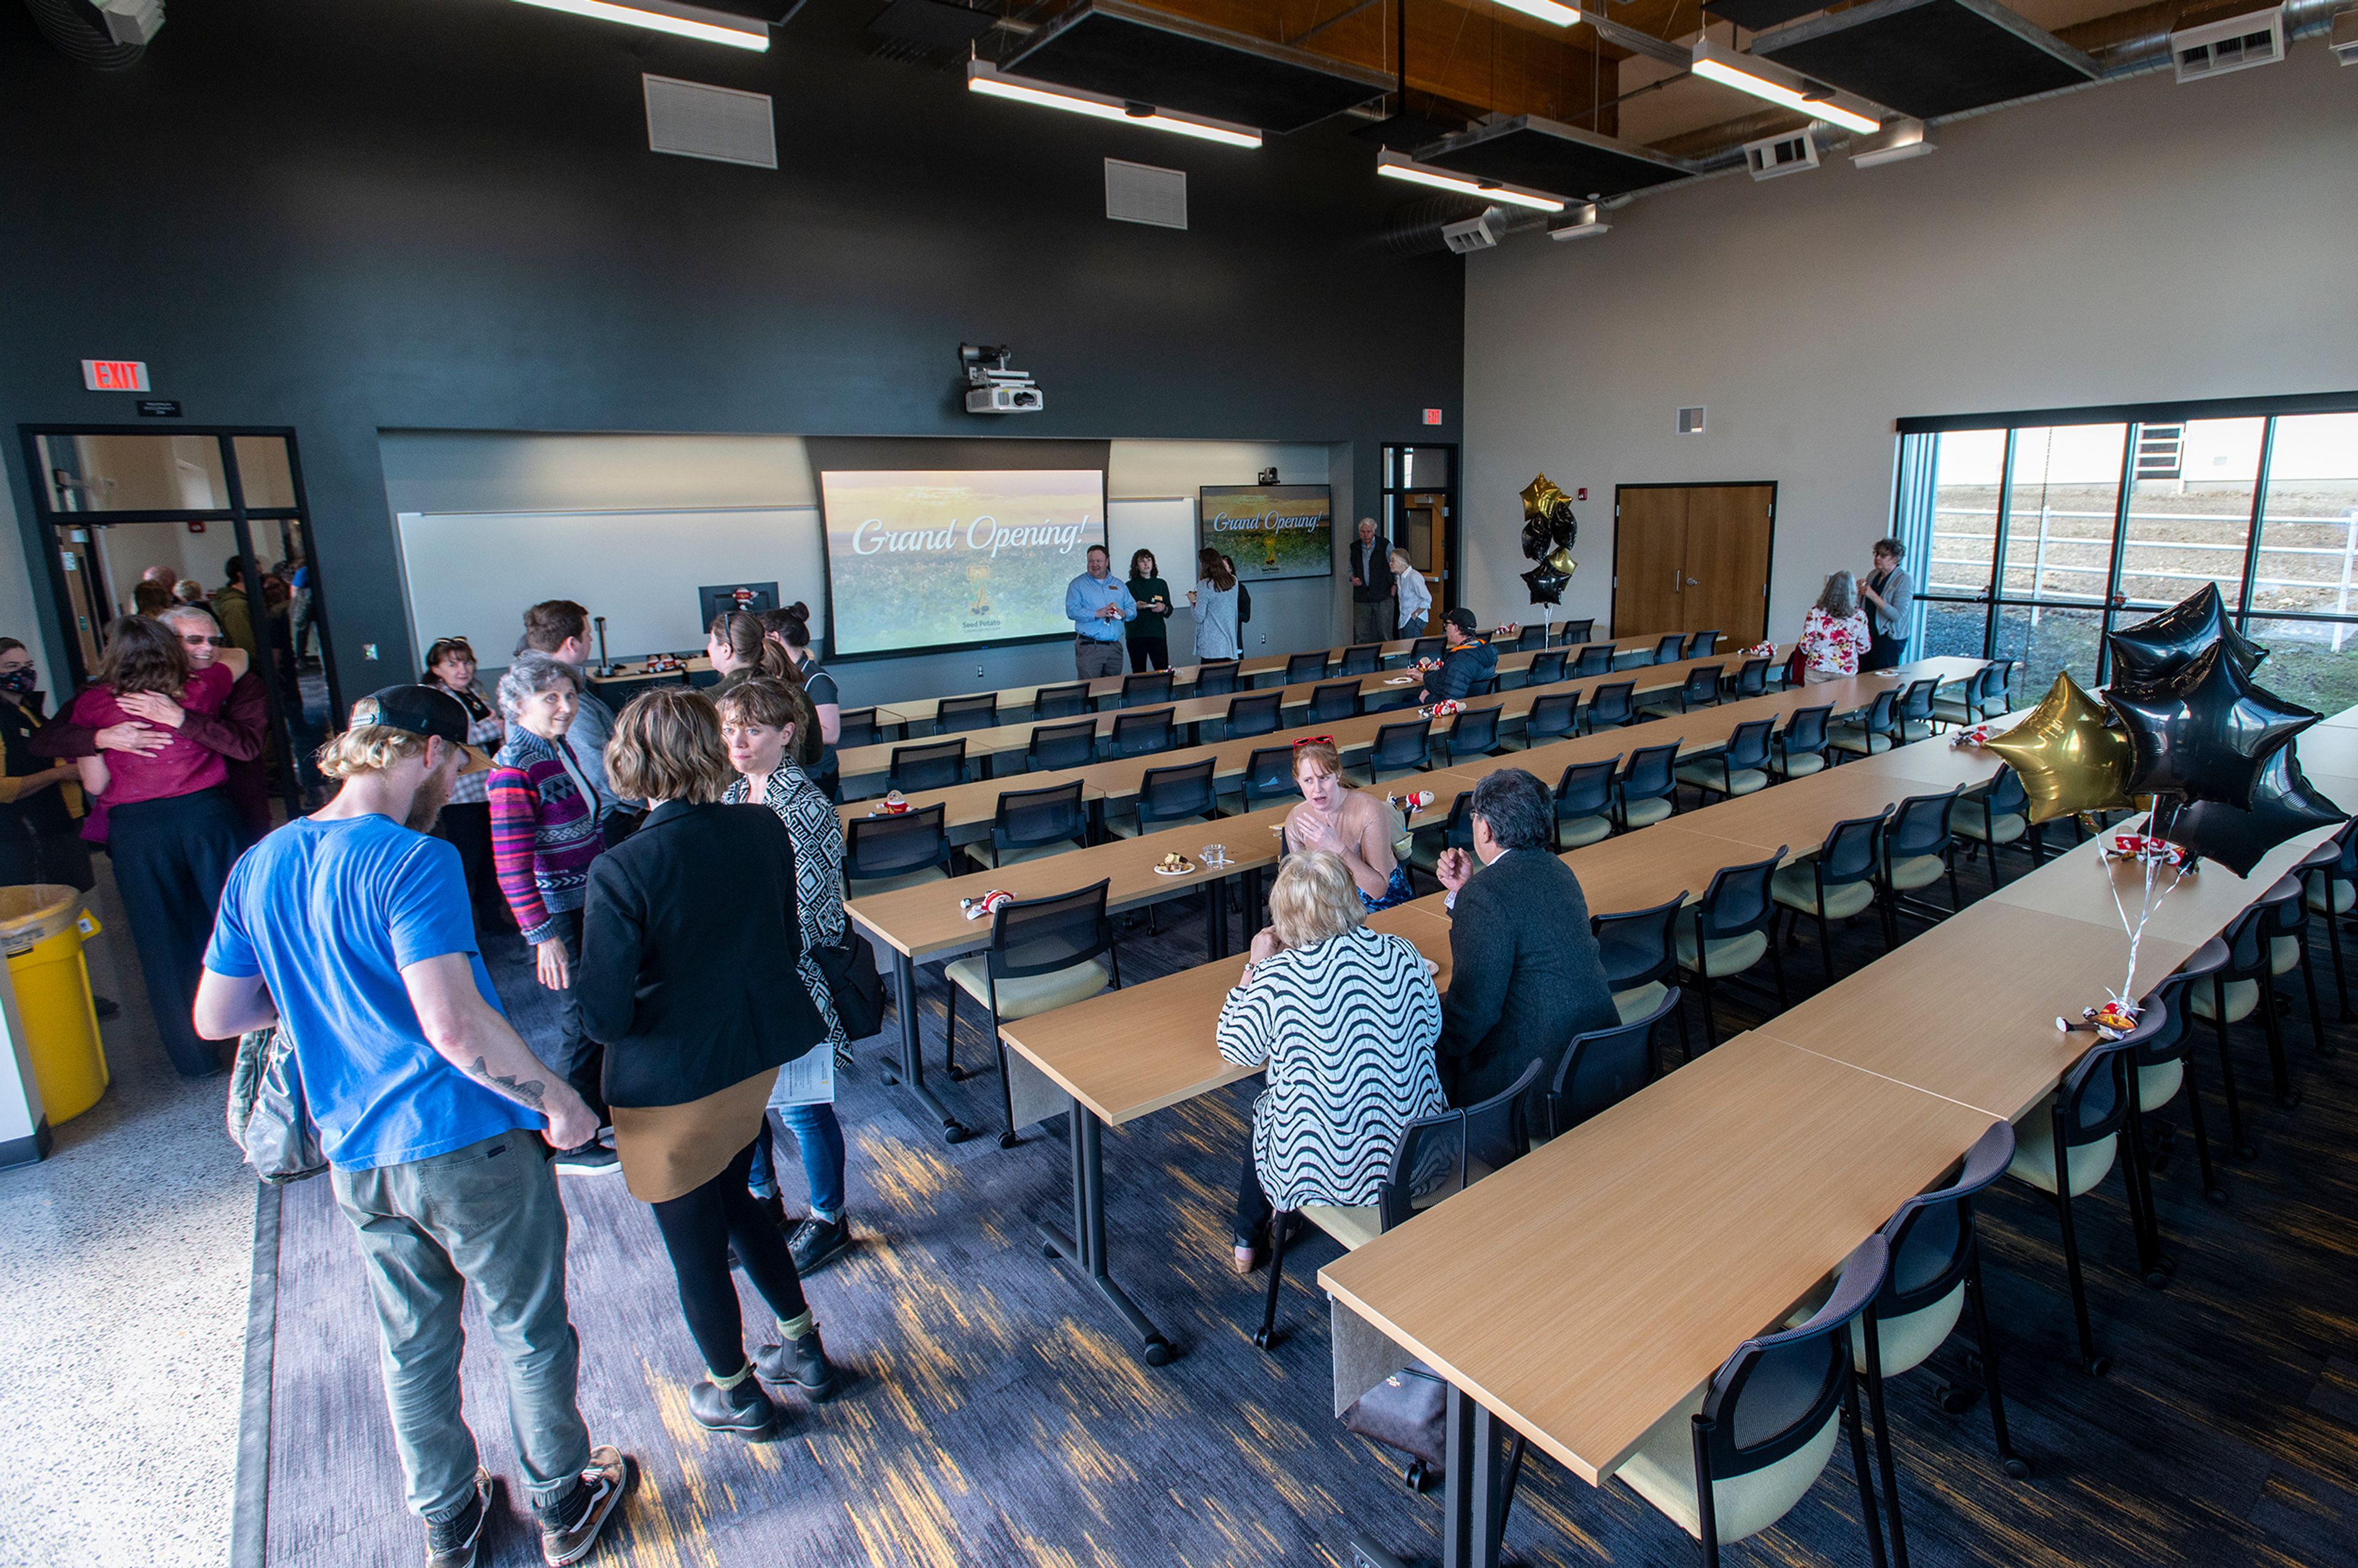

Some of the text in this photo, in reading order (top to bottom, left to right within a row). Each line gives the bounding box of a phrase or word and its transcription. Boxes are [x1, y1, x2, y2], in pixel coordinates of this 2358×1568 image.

[93, 362, 138, 389] EXIT
[1427, 409, 1440, 424] EXIT
[1213, 510, 1323, 534] Grand Opening!
[852, 515, 1089, 558] Grand Opening!
